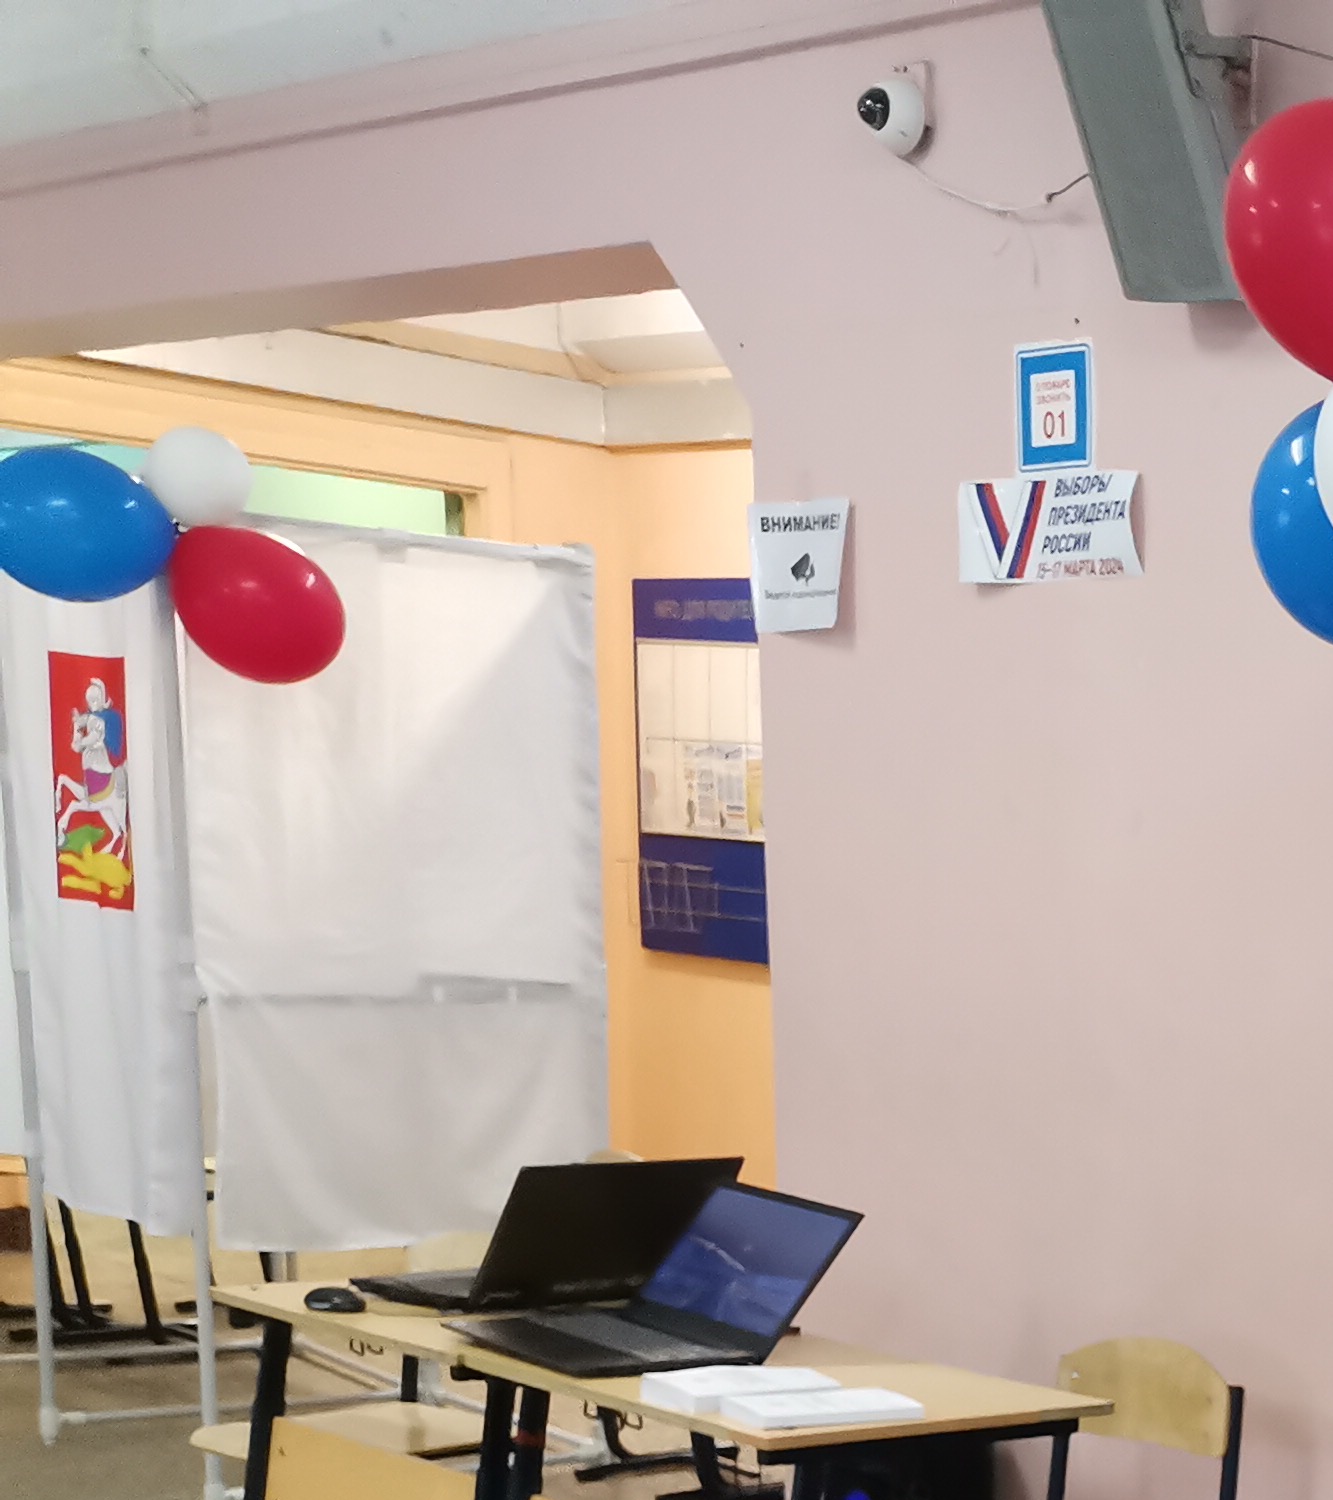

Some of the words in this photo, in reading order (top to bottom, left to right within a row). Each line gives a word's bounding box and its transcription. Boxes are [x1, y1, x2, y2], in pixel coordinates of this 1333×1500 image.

[1043, 410, 1065, 439] 01
[1054, 474, 1113, 498] ВЫБОРЫ
[1048, 500, 1127, 526] ПРЕЗИДЕНТА
[1042, 532, 1092, 555] РОССИИ
